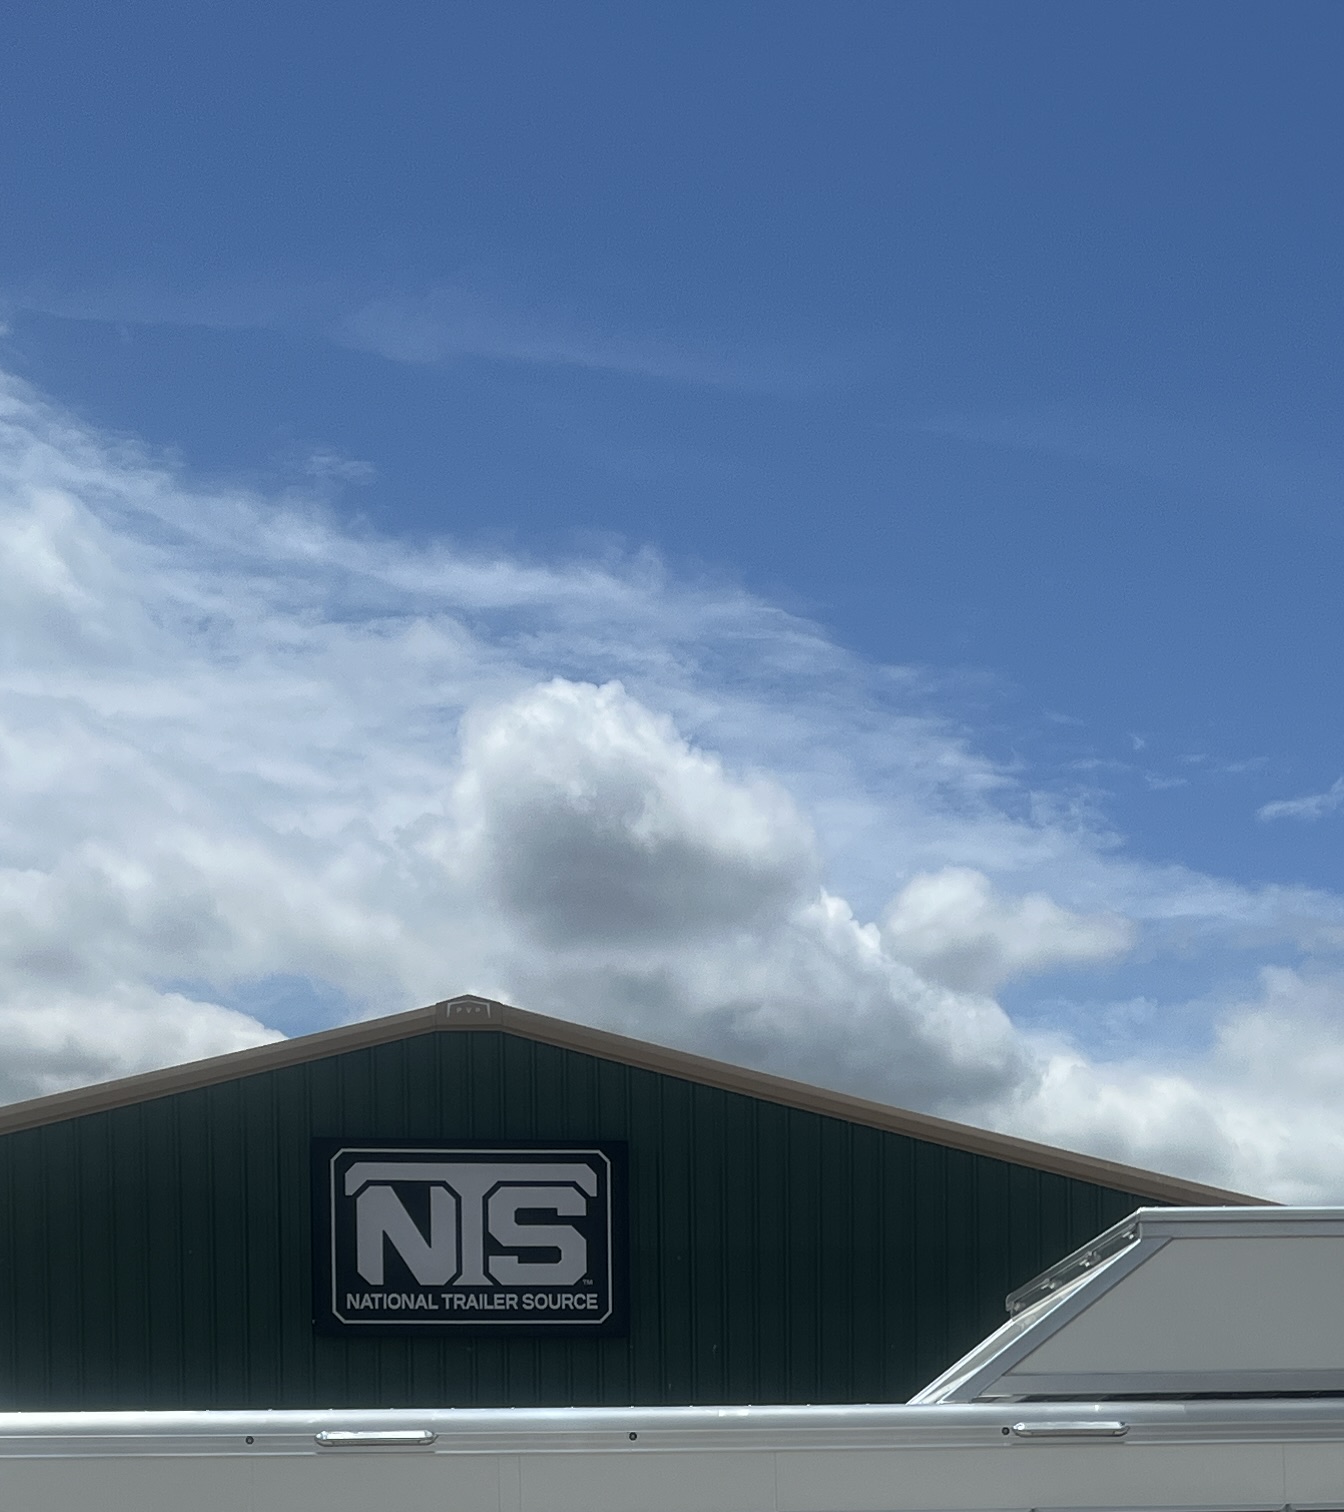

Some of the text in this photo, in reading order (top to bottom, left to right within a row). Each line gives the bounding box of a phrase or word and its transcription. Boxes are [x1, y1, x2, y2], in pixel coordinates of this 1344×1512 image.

[344, 1162, 597, 1286] NTS
[346, 1293, 599, 1310] NATIONAL TRAILER SOURCE
